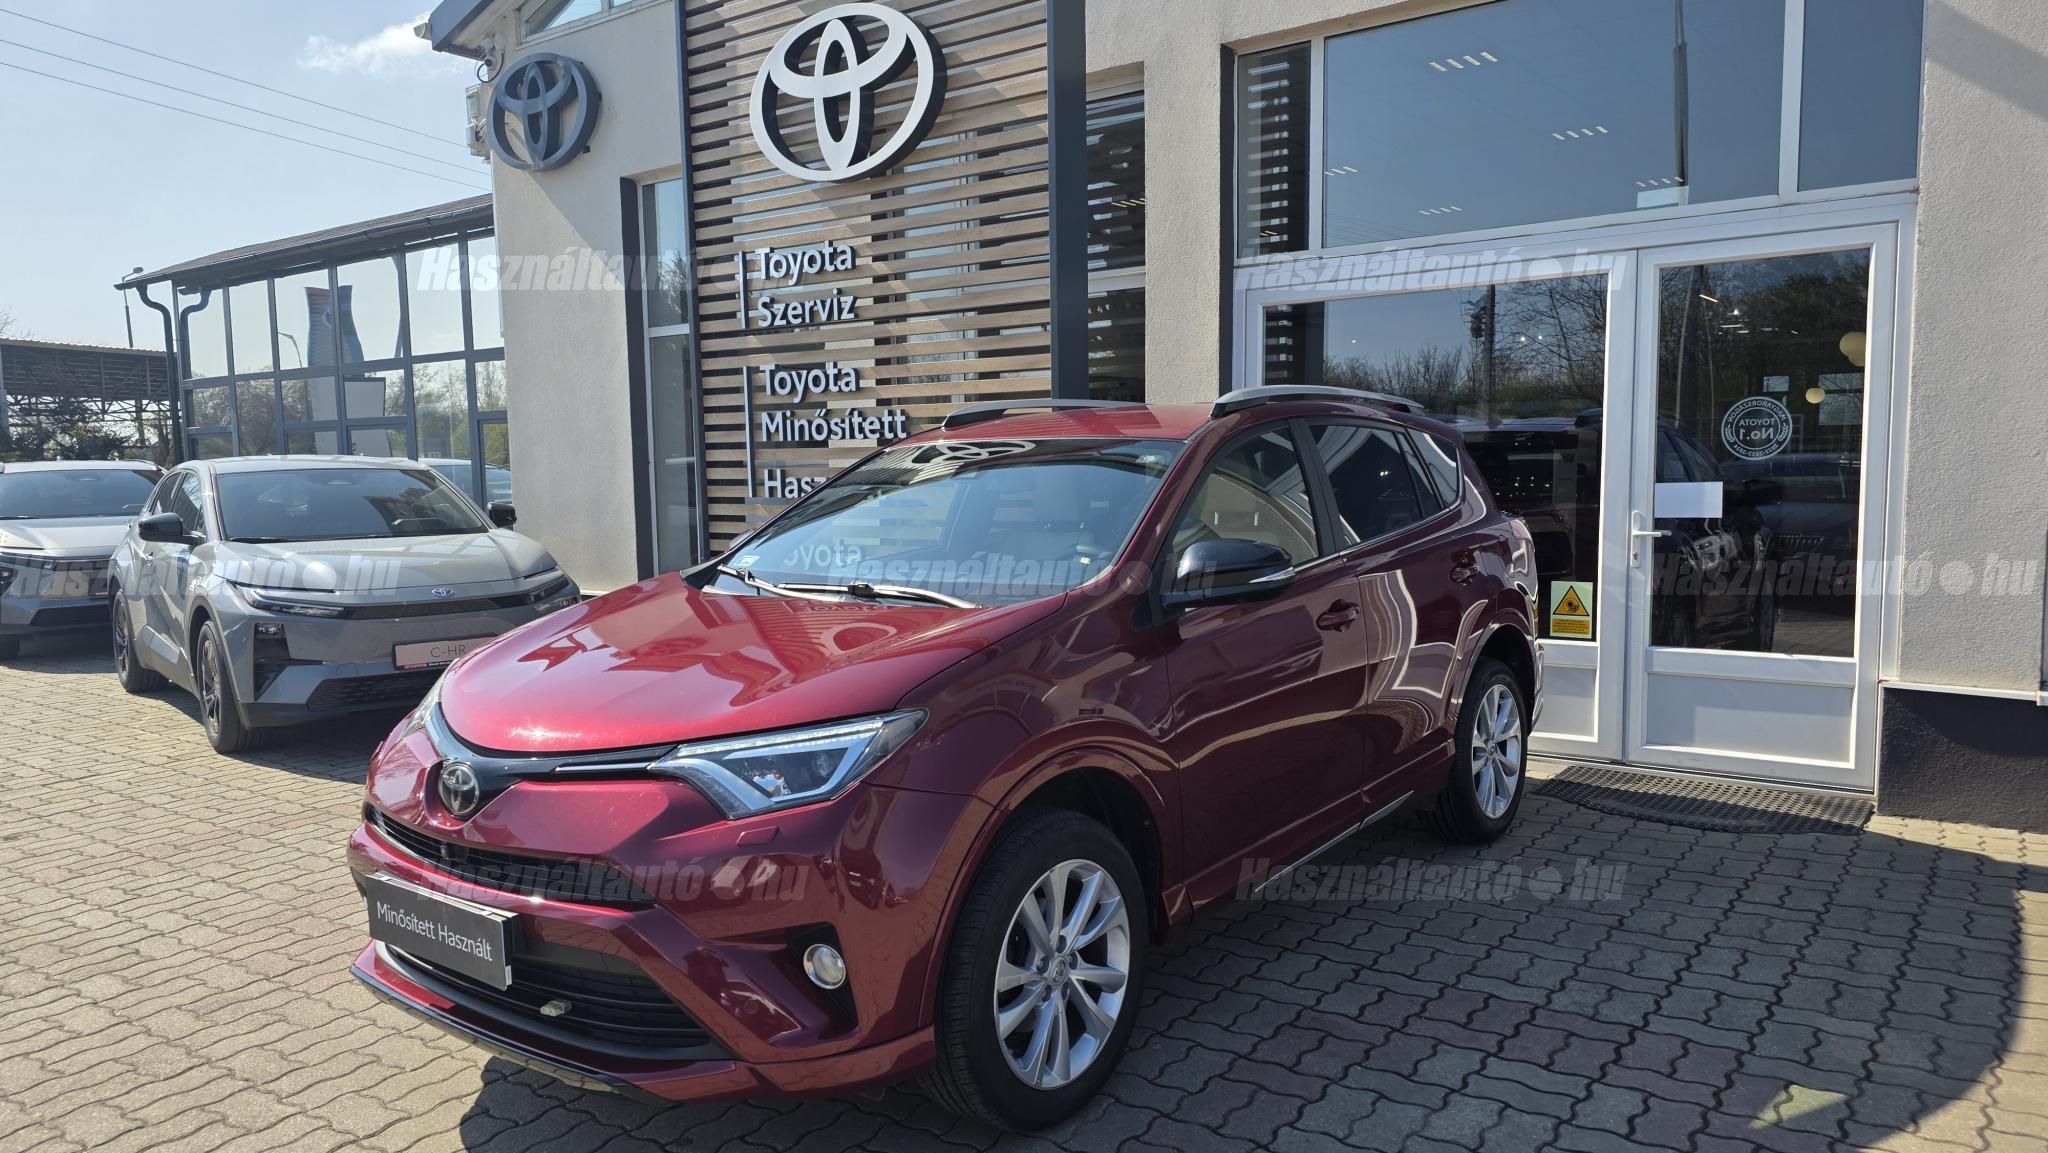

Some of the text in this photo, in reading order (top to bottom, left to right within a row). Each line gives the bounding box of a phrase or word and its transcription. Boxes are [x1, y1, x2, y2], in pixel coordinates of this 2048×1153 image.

[755, 240, 856, 286] Toyota
[758, 288, 856, 328] Szerviz
[760, 361, 858, 403] Toyota
[761, 408, 908, 442] Minősített
[430, 644, 466, 658] C-HR
[376, 900, 493, 962] Minősített Használt
